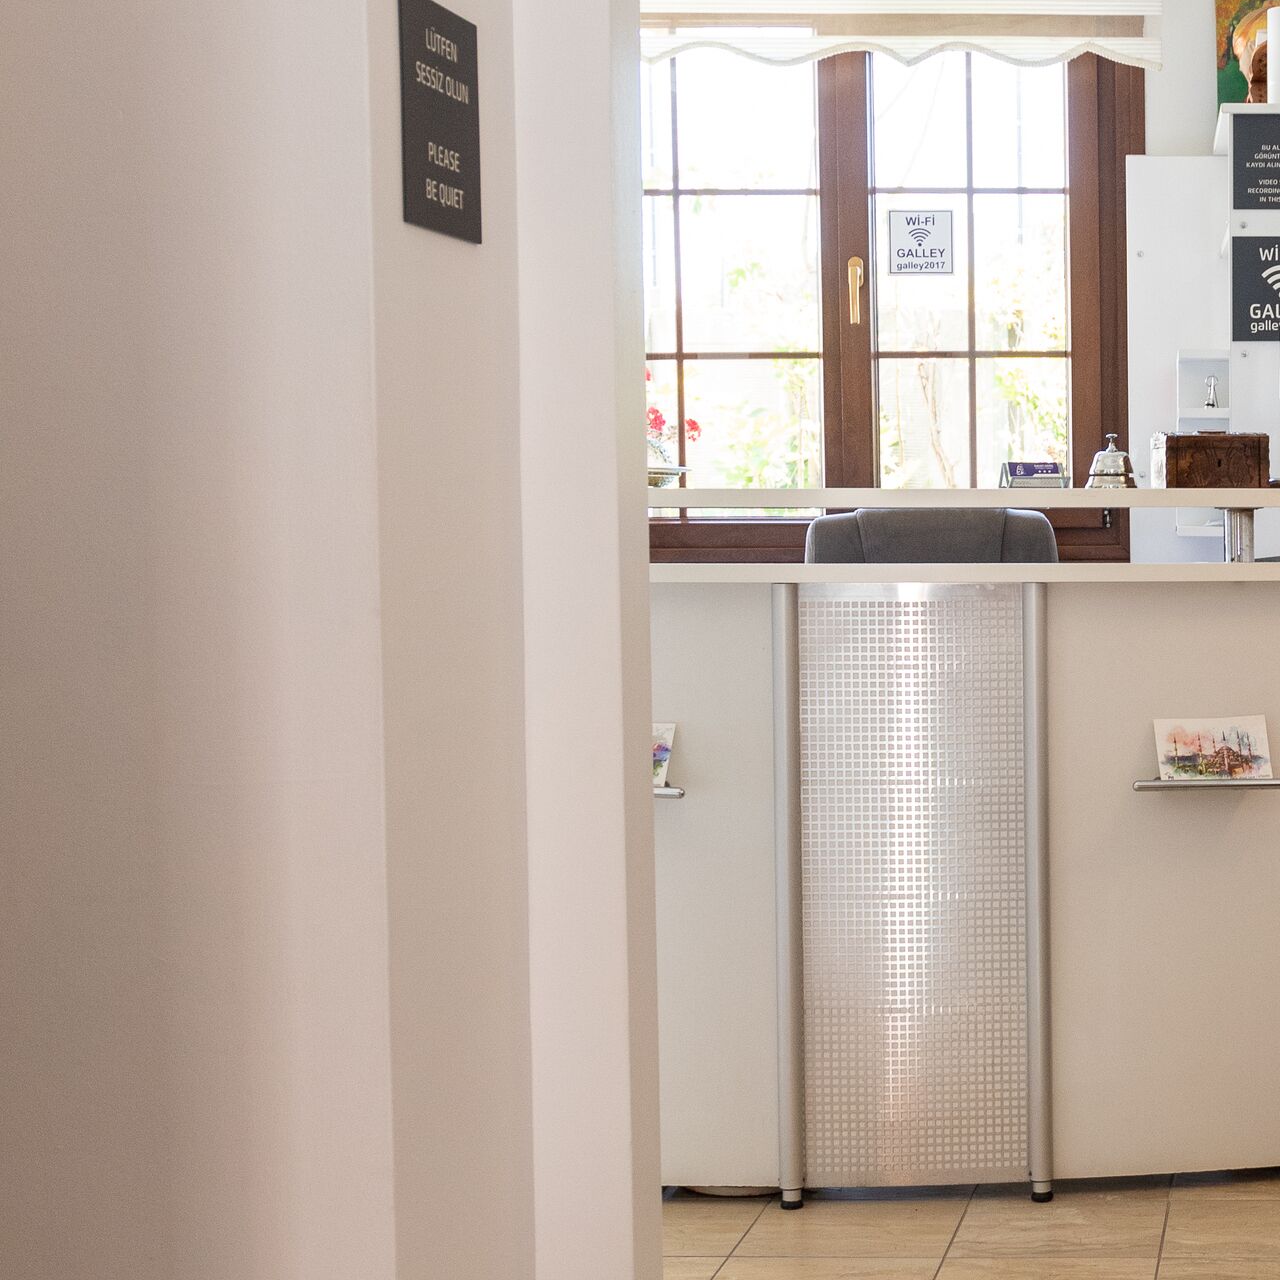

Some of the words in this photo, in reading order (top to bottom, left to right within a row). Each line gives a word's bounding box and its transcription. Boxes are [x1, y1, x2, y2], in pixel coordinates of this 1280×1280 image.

[426, 27, 457, 63] LÜTFEN
[446, 76, 469, 104] OLUN
[428, 141, 460, 173] PLEASE
[426, 178, 438, 201] BE
[439, 183, 464, 210] QUIET
[896, 248, 946, 258] GALLEY
[896, 261, 946, 271] galley2017
